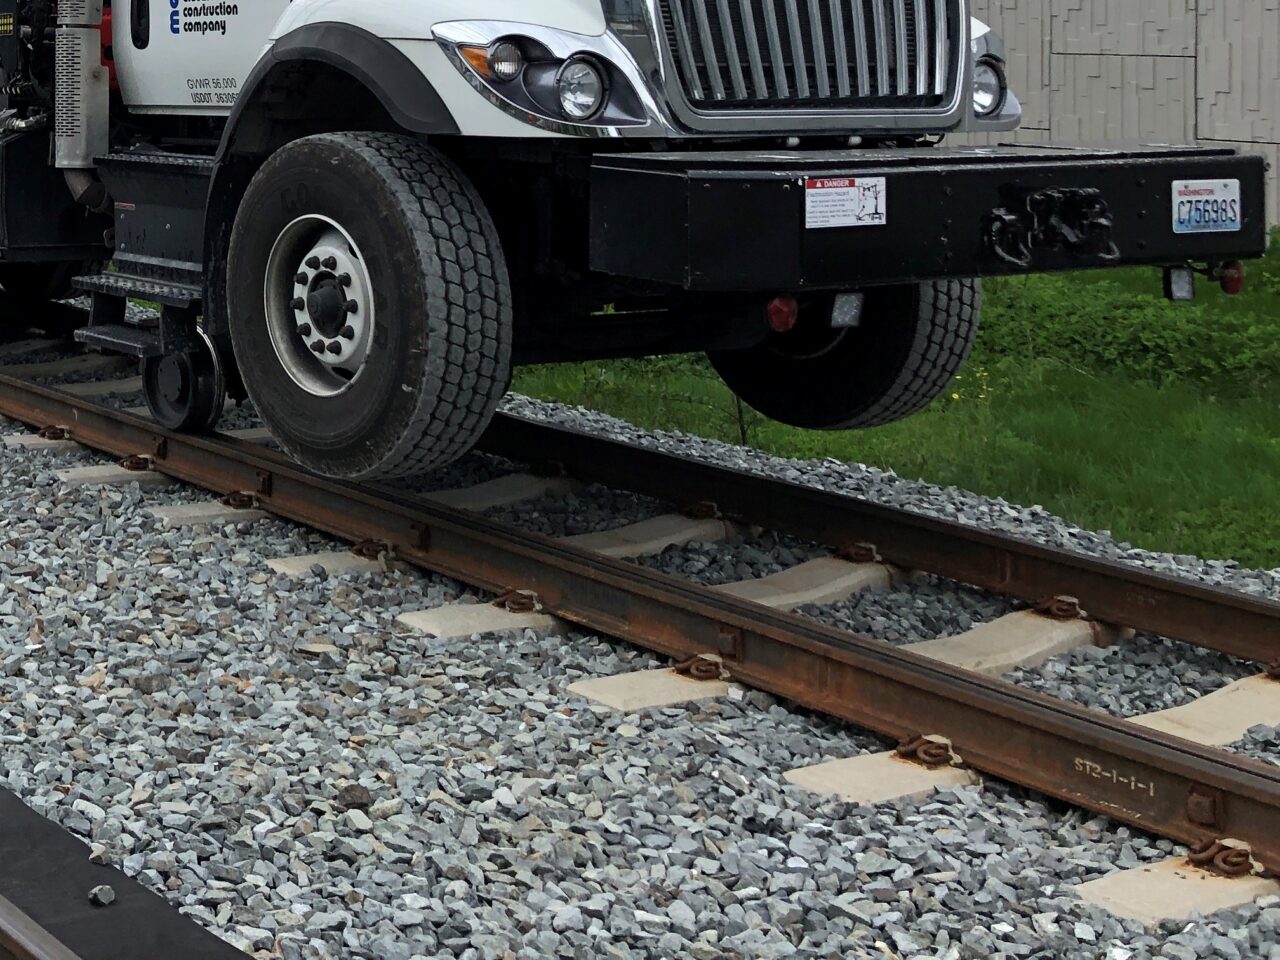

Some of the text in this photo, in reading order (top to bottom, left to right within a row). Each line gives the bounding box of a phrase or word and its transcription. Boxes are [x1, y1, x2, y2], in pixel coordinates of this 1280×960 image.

[183, 1, 239, 17] construction
[183, 20, 227, 36] company
[186, 78, 237, 90] GVWR 56,000
[191, 92, 213, 104] USDOT
[823, 179, 850, 188] DANGER
[1177, 198, 1237, 225] C75698S
